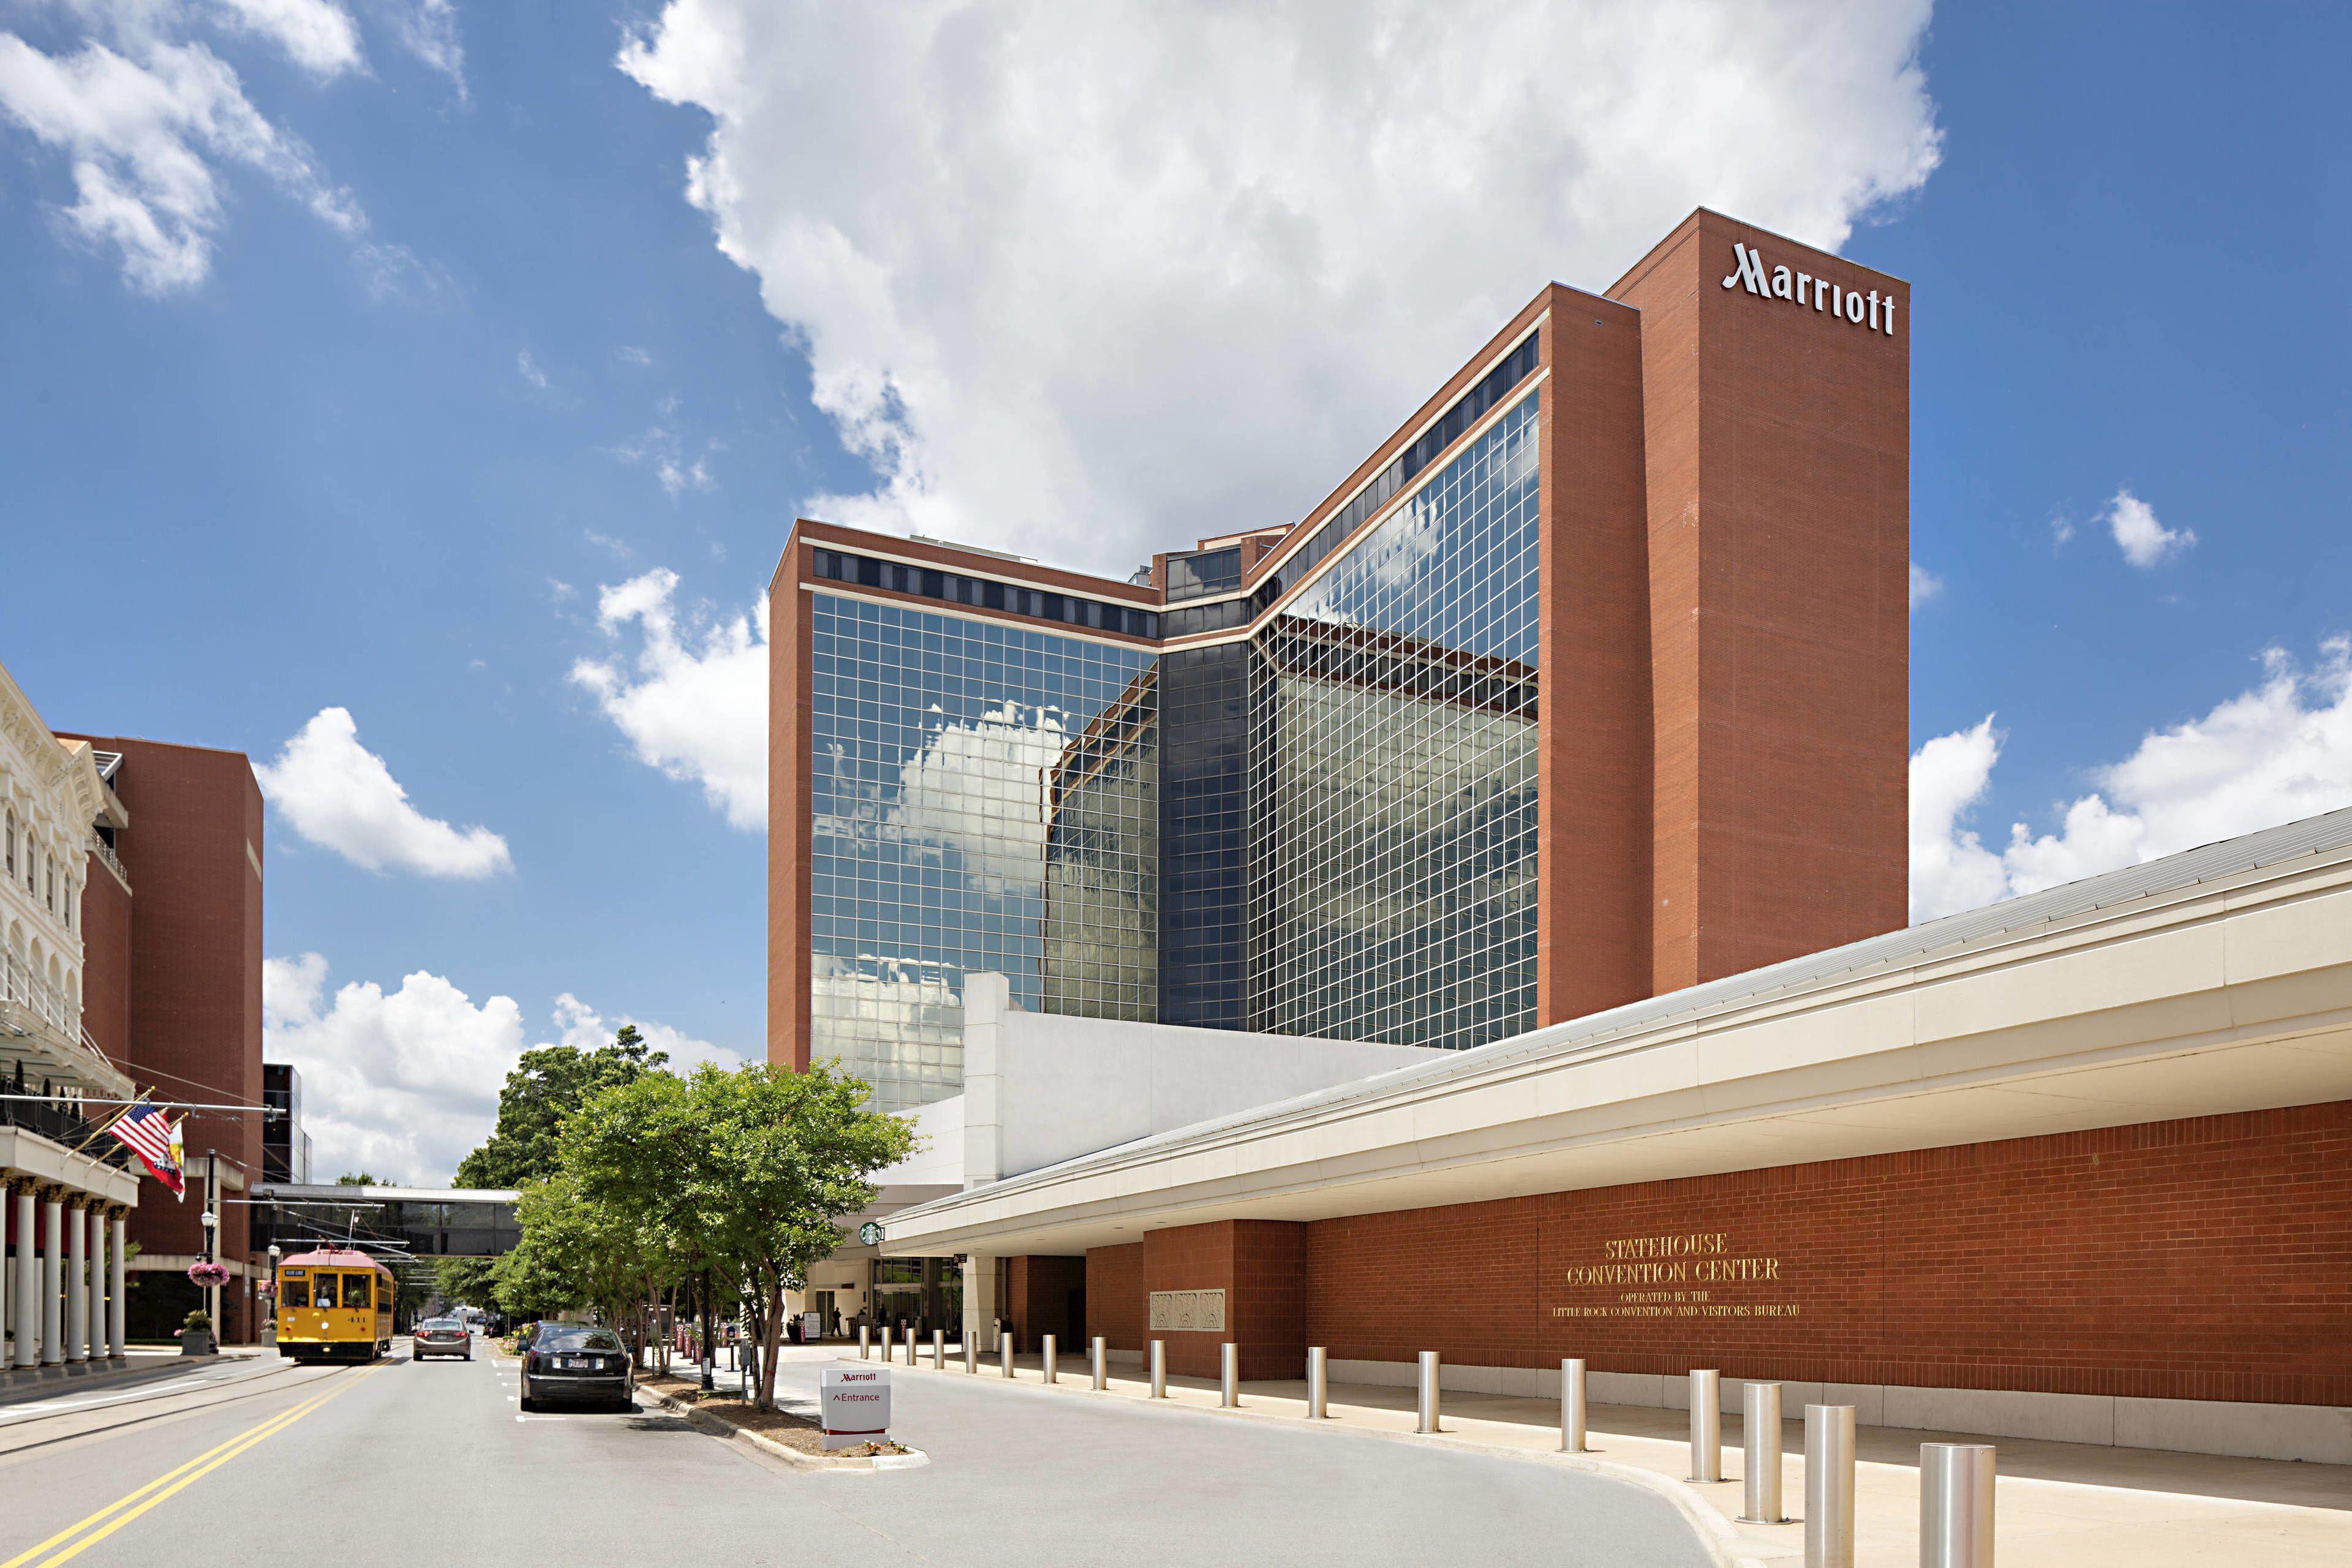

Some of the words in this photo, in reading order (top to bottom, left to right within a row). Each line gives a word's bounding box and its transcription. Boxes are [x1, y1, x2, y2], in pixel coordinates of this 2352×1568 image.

[1721, 242, 1896, 336] Marriott
[1605, 1232, 1728, 1260] STATEHOUSE
[1567, 1261, 1687, 1286] CONVENTION
[1695, 1257, 1780, 1281] CENTER
[1621, 1292, 1671, 1303] OPERATED
[1675, 1291, 1686, 1302] BY
[1691, 1291, 1711, 1302] THE
[1553, 1307, 1581, 1317] LITTLE
[1584, 1306, 1608, 1317] ROCK
[1611, 1306, 1672, 1317] CONVENTION
[1676, 1305, 1698, 1316] AND
[1702, 1305, 1751, 1316] VISITORS
[1755, 1304, 1800, 1316] BUREAU
[840, 1373, 876, 1382] Marriott
